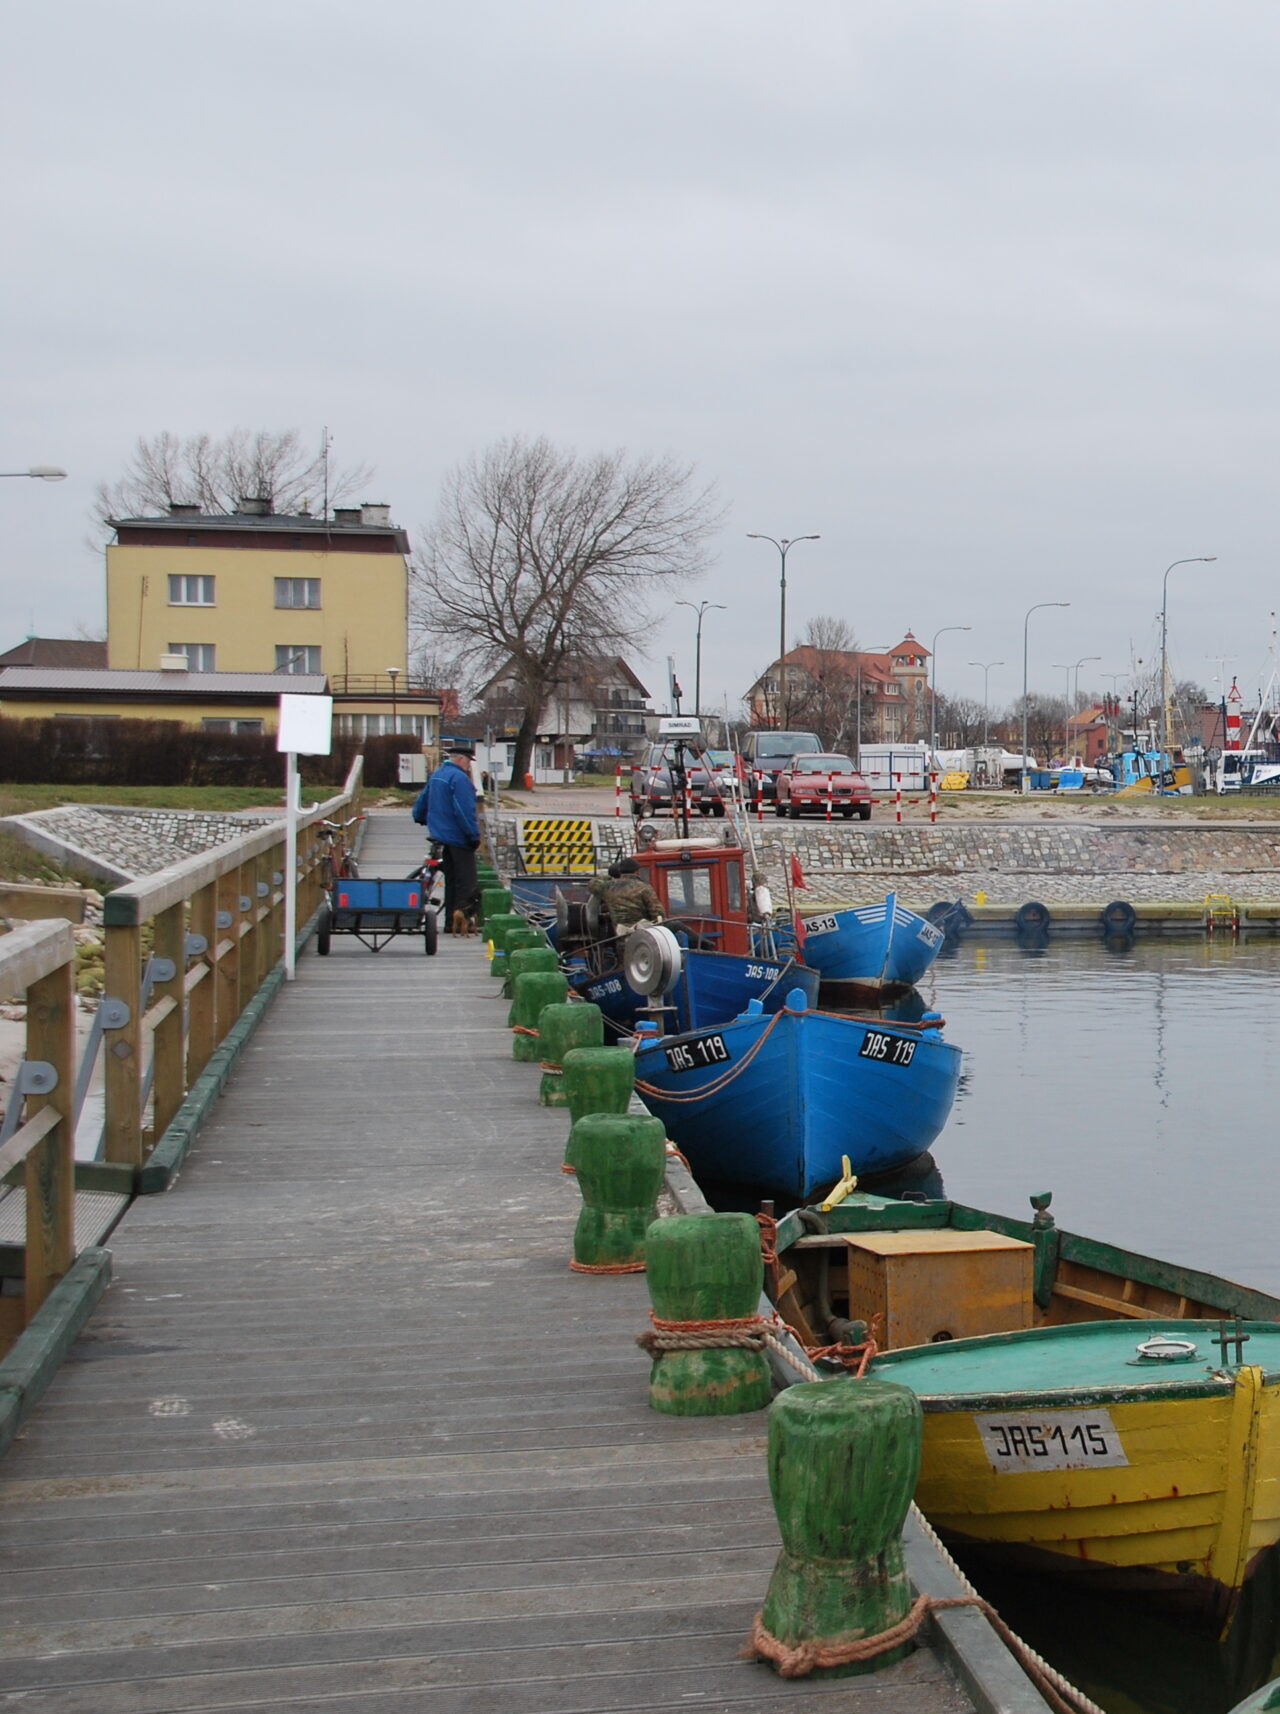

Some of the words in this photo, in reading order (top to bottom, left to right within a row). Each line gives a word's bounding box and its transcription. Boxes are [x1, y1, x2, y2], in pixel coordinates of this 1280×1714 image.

[806, 917, 836, 933] AS-13
[666, 1045, 695, 1071] JAS
[697, 1036, 728, 1062] 119
[861, 1032, 891, 1059] JAS
[893, 1040, 916, 1065] 119
